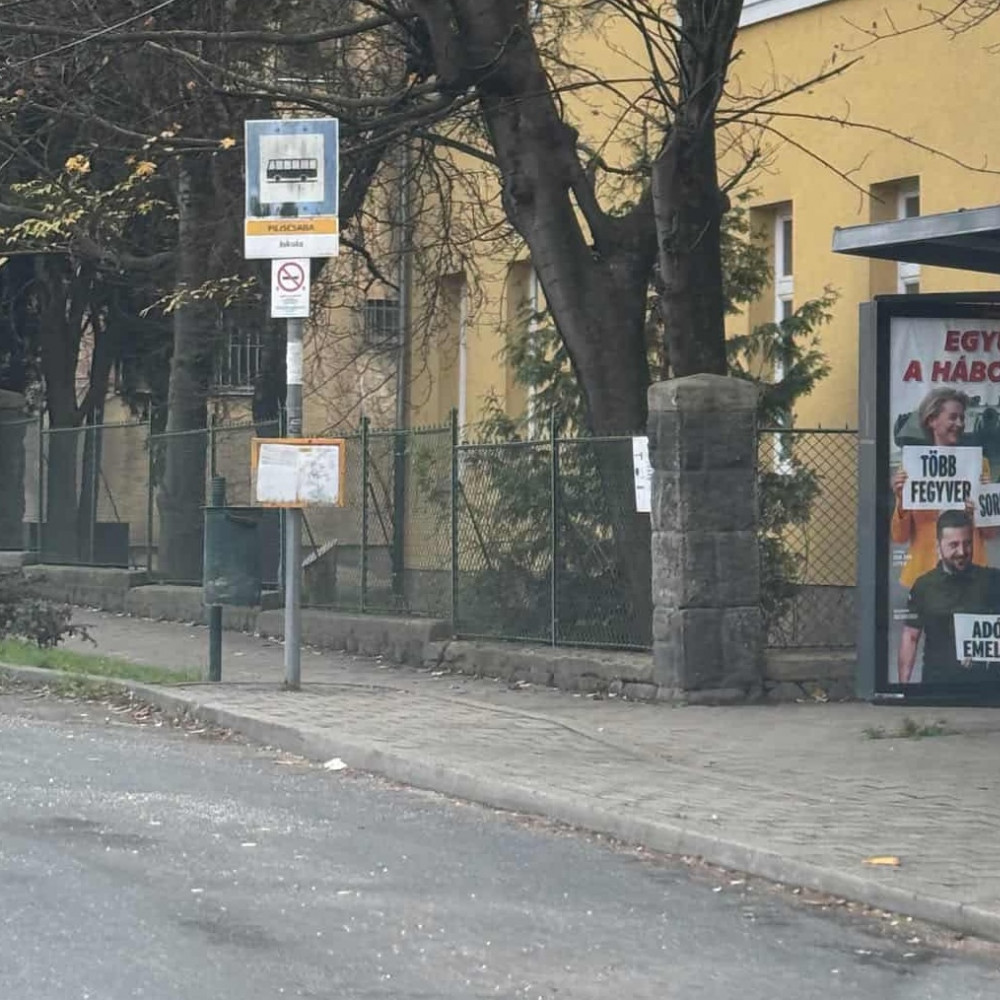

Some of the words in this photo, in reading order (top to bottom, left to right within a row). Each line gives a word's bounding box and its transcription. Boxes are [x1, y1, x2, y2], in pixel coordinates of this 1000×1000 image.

[902, 359, 923, 383] A
[920, 450, 957, 478] TÖBB
[911, 480, 971, 504] FEGYVER
